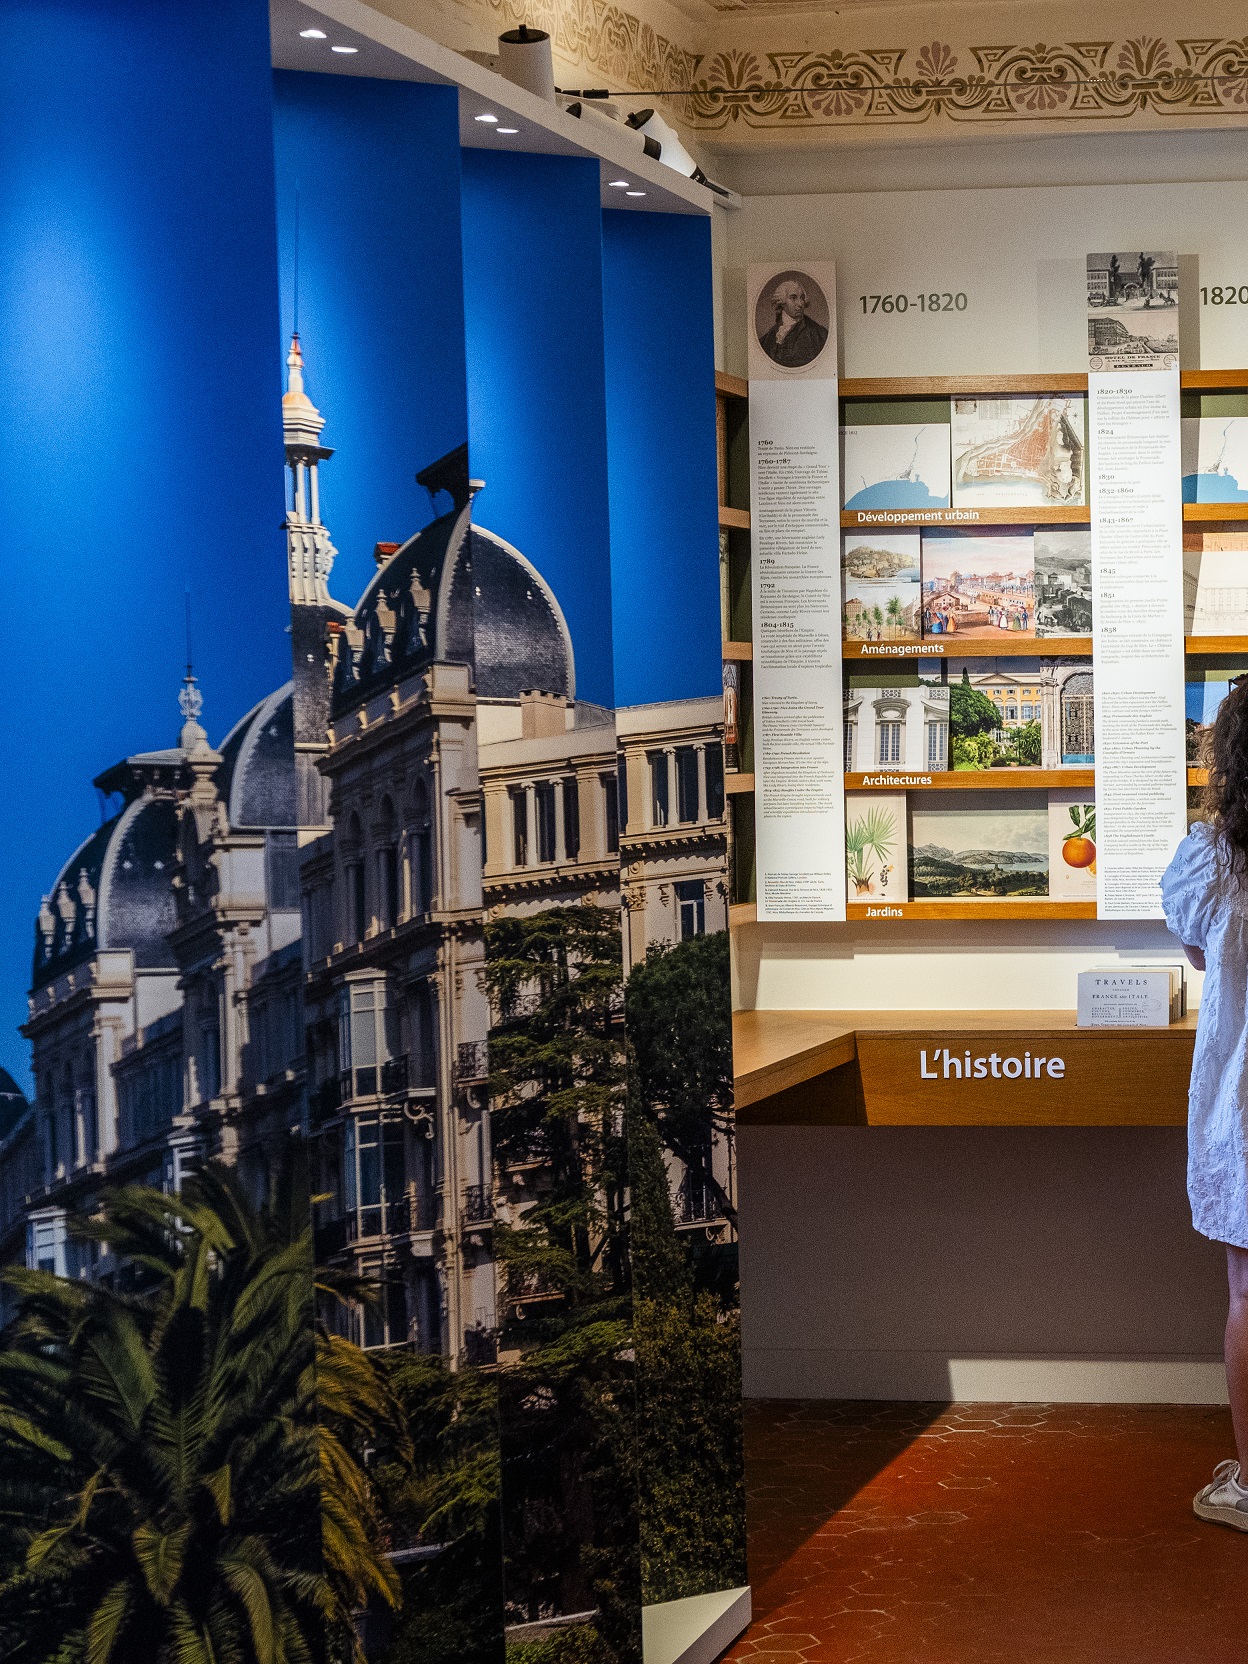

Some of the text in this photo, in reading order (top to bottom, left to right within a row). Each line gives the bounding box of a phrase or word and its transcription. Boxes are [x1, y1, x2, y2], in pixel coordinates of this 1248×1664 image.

[859, 292, 969, 315] 1760-1820
[858, 510, 979, 524] Développement urbain
[861, 644, 944, 656] Aménagements
[862, 776, 932, 786] Architectures
[866, 907, 902, 917] Jardins
[920, 1050, 1066, 1080] L'histoire
